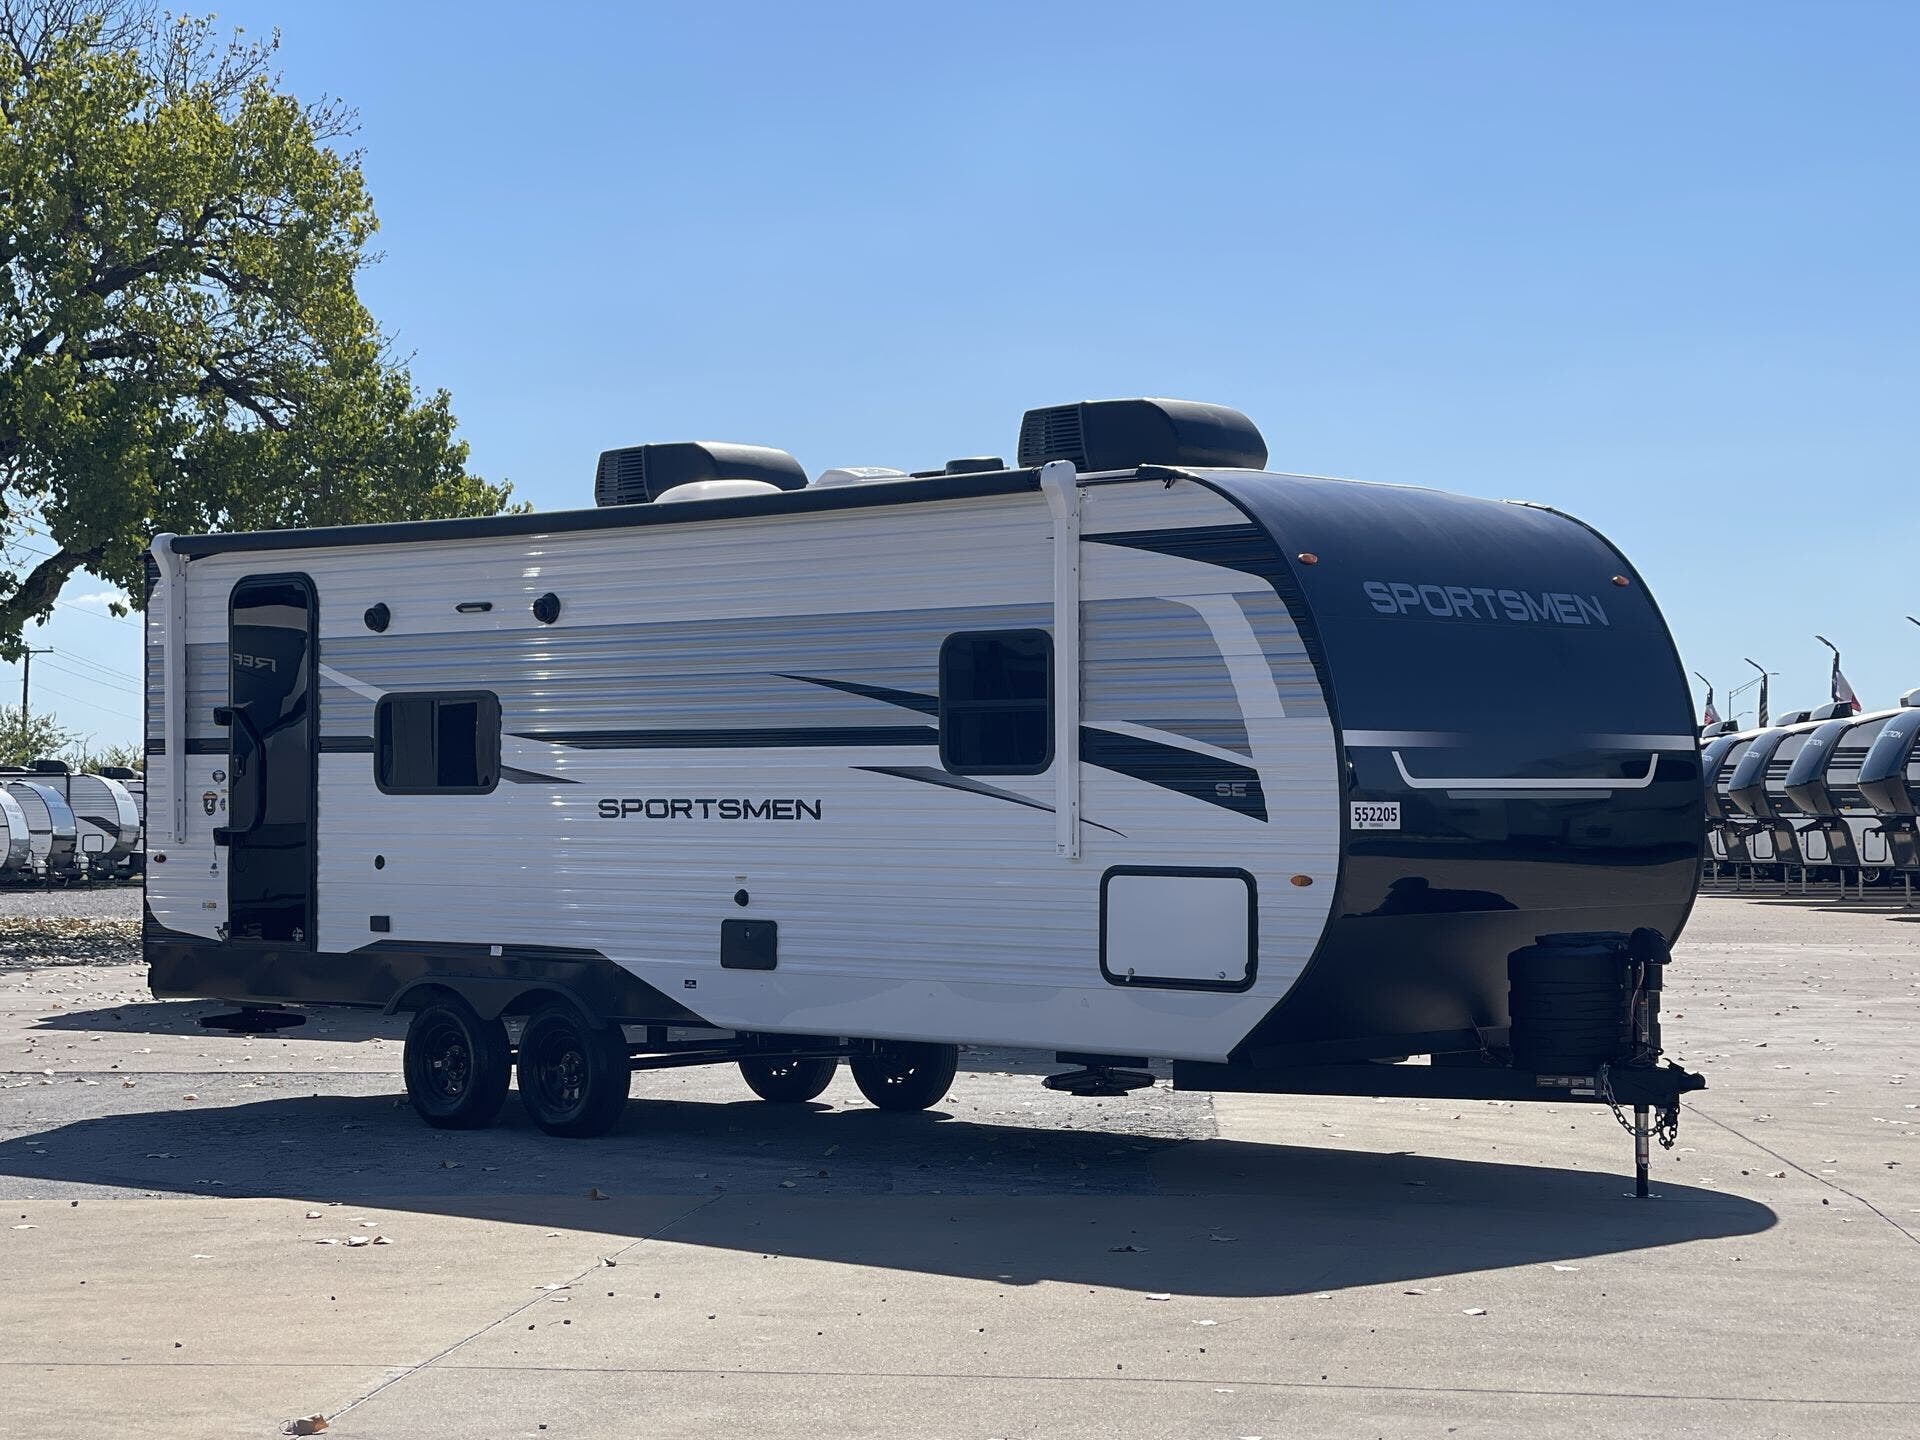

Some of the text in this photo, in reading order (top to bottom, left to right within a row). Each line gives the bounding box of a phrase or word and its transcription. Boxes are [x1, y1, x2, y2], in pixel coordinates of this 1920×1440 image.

[1363, 581, 1610, 626] SPORTSMEN
[1215, 783, 1247, 796] SE
[598, 798, 822, 820] SPORTSMEN
[1354, 806, 1398, 822] 552205
